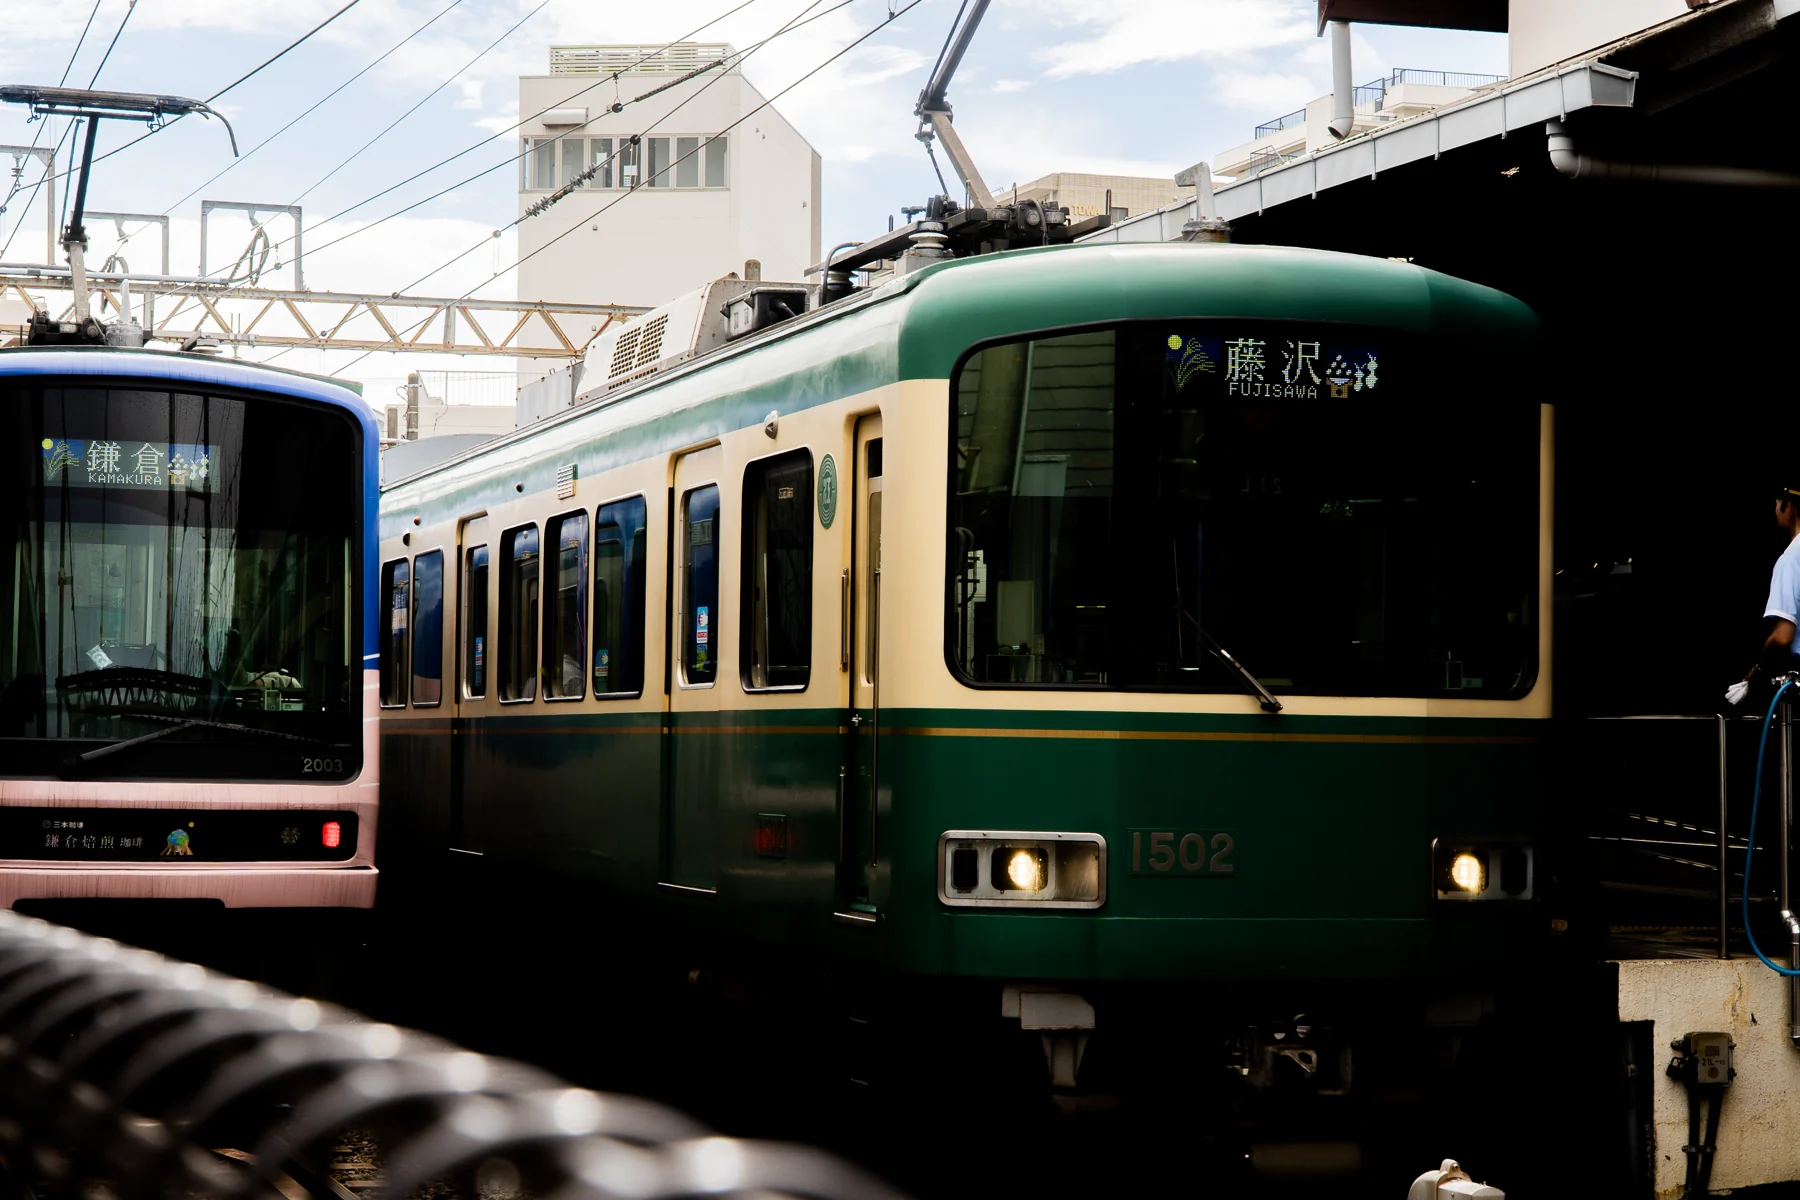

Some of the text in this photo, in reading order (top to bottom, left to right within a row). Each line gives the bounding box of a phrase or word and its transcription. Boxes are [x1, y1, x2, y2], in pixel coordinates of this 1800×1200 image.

[1225, 338, 1321, 384] 藤沢
[1229, 382, 1318, 399] FUJISAWA
[87, 440, 165, 474] 鎌倉
[88, 472, 162, 485] KAMAKURA
[303, 757, 344, 773] 2003
[1132, 831, 1236, 872] 1502
